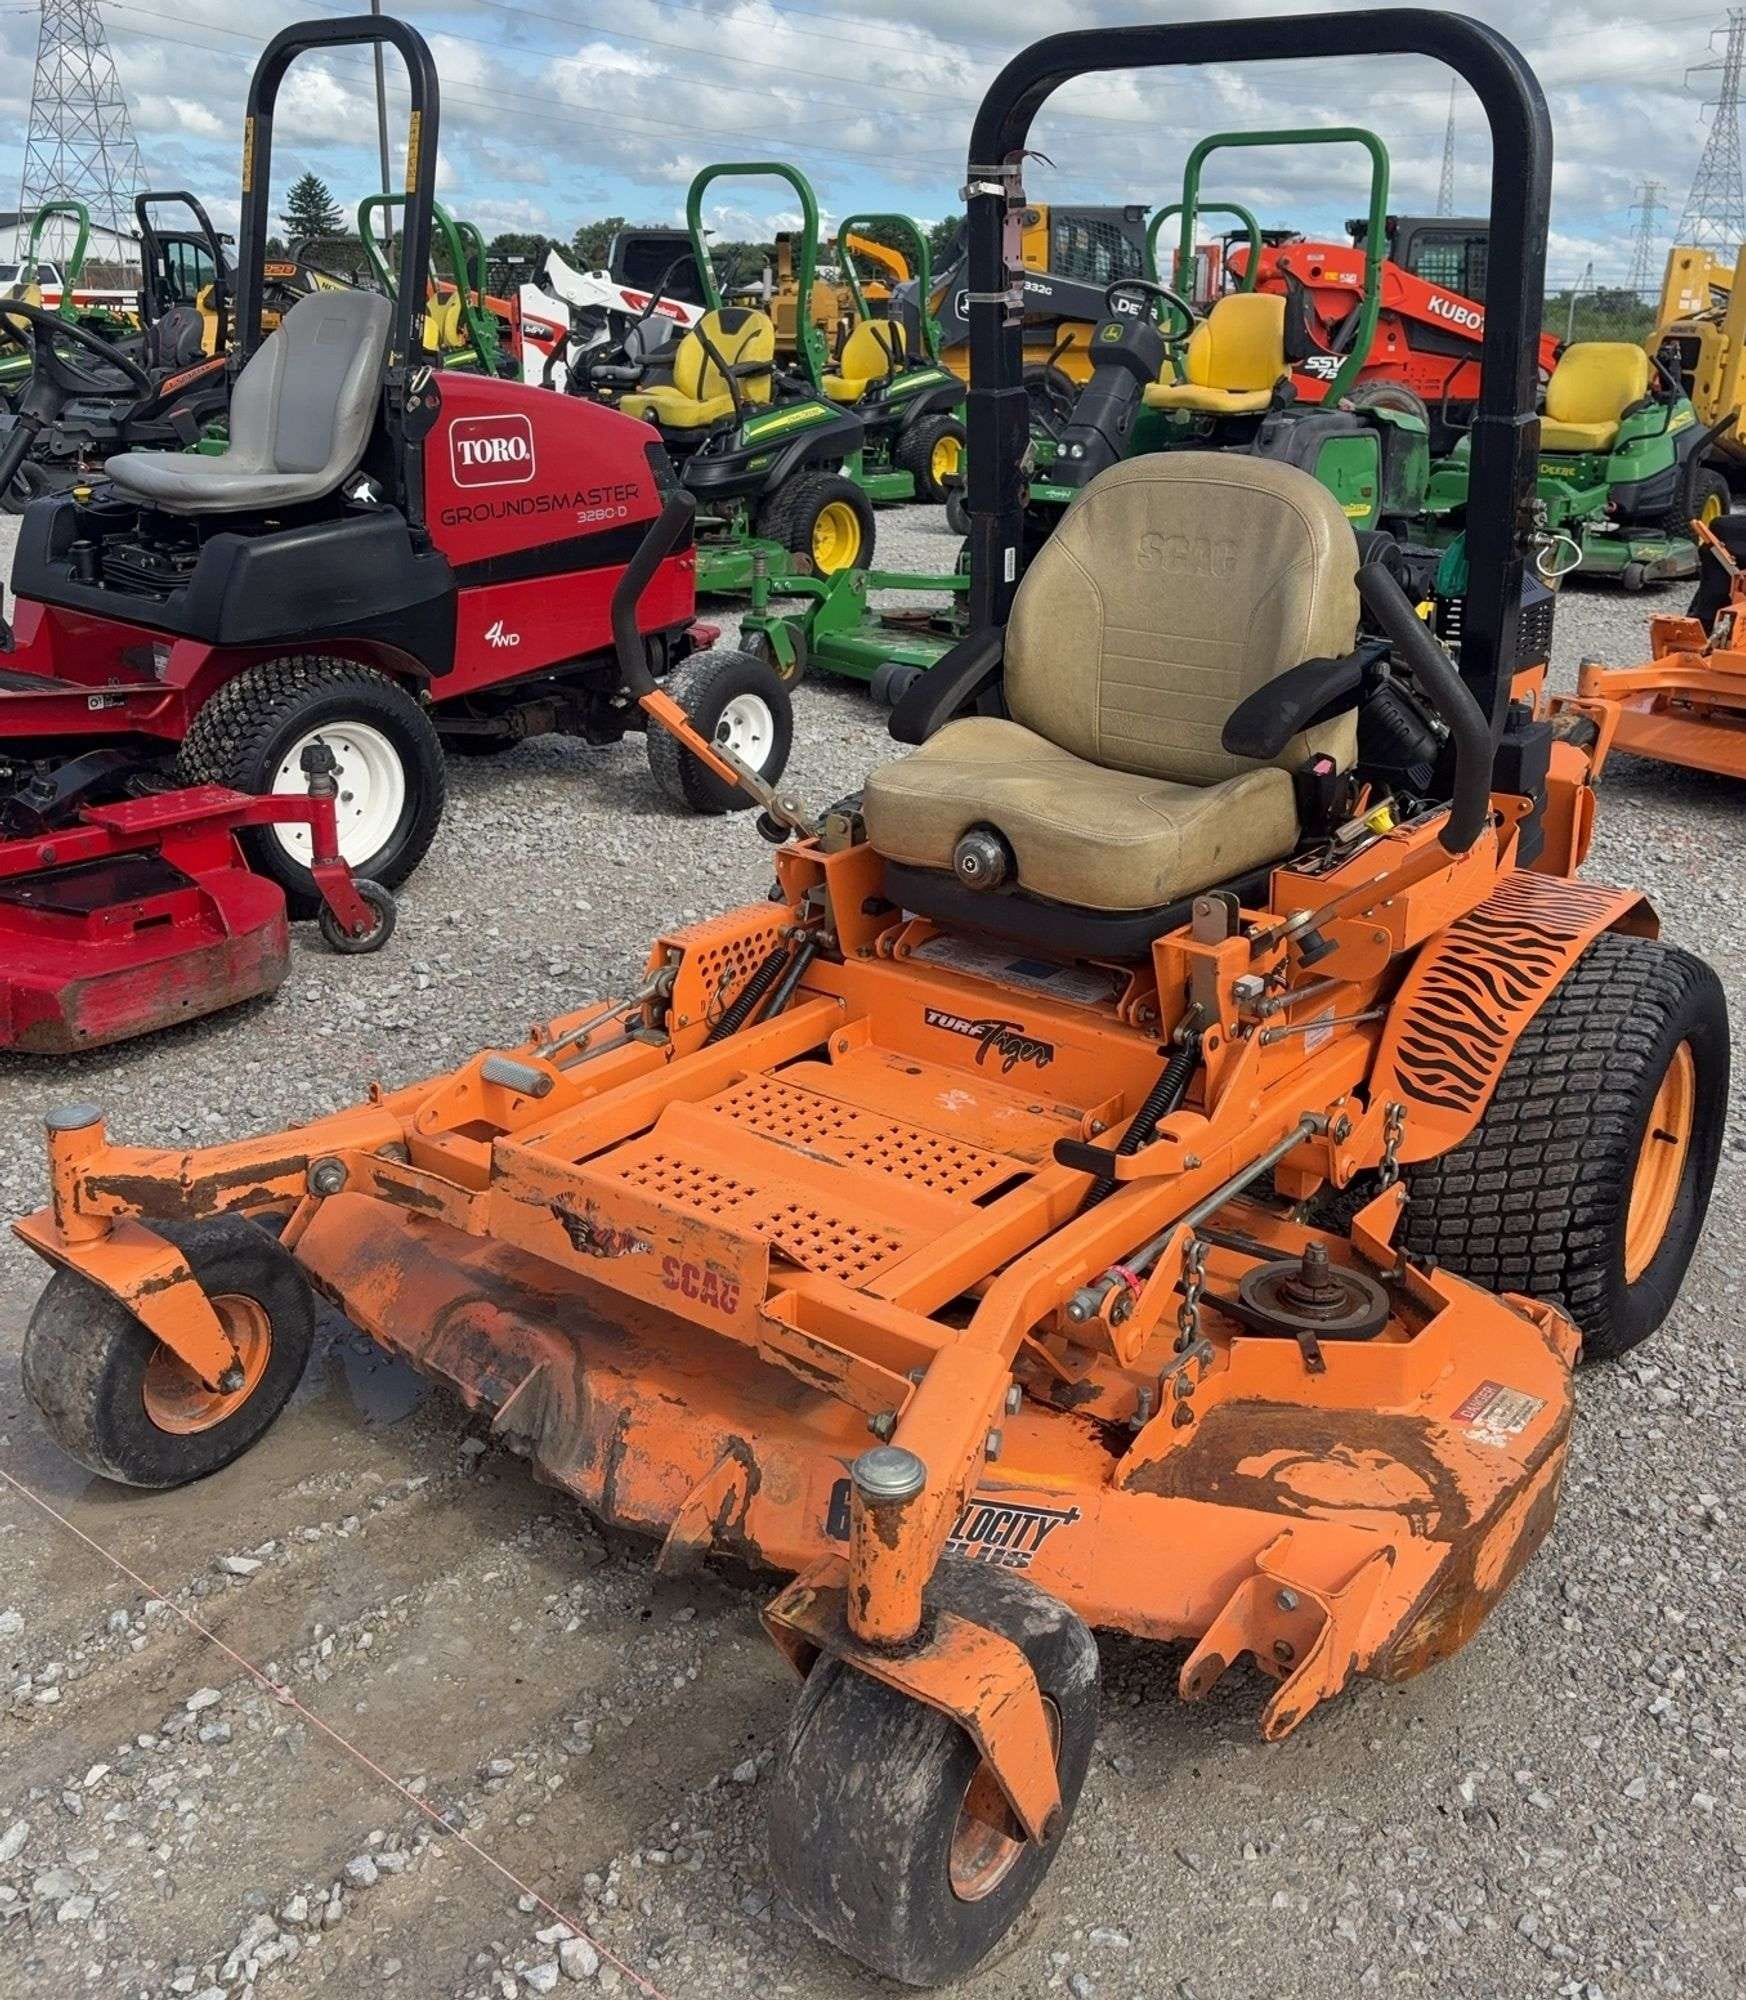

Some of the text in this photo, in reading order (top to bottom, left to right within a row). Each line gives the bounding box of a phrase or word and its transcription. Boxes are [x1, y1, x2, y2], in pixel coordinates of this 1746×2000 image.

[1023, 281, 1053, 296] 332G
[1427, 295, 1485, 334] KUBO
[1304, 356, 1349, 370] SSV
[1317, 368, 1339, 379] 75
[458, 436, 527, 466] TORO
[440, 483, 640, 527] GROUNDSMASTER
[1137, 530, 1240, 580] SCAG
[484, 620, 521, 648] 4WD
[927, 1010, 1053, 1074] TURF Tiger
[662, 1255, 741, 1315] SCAG
